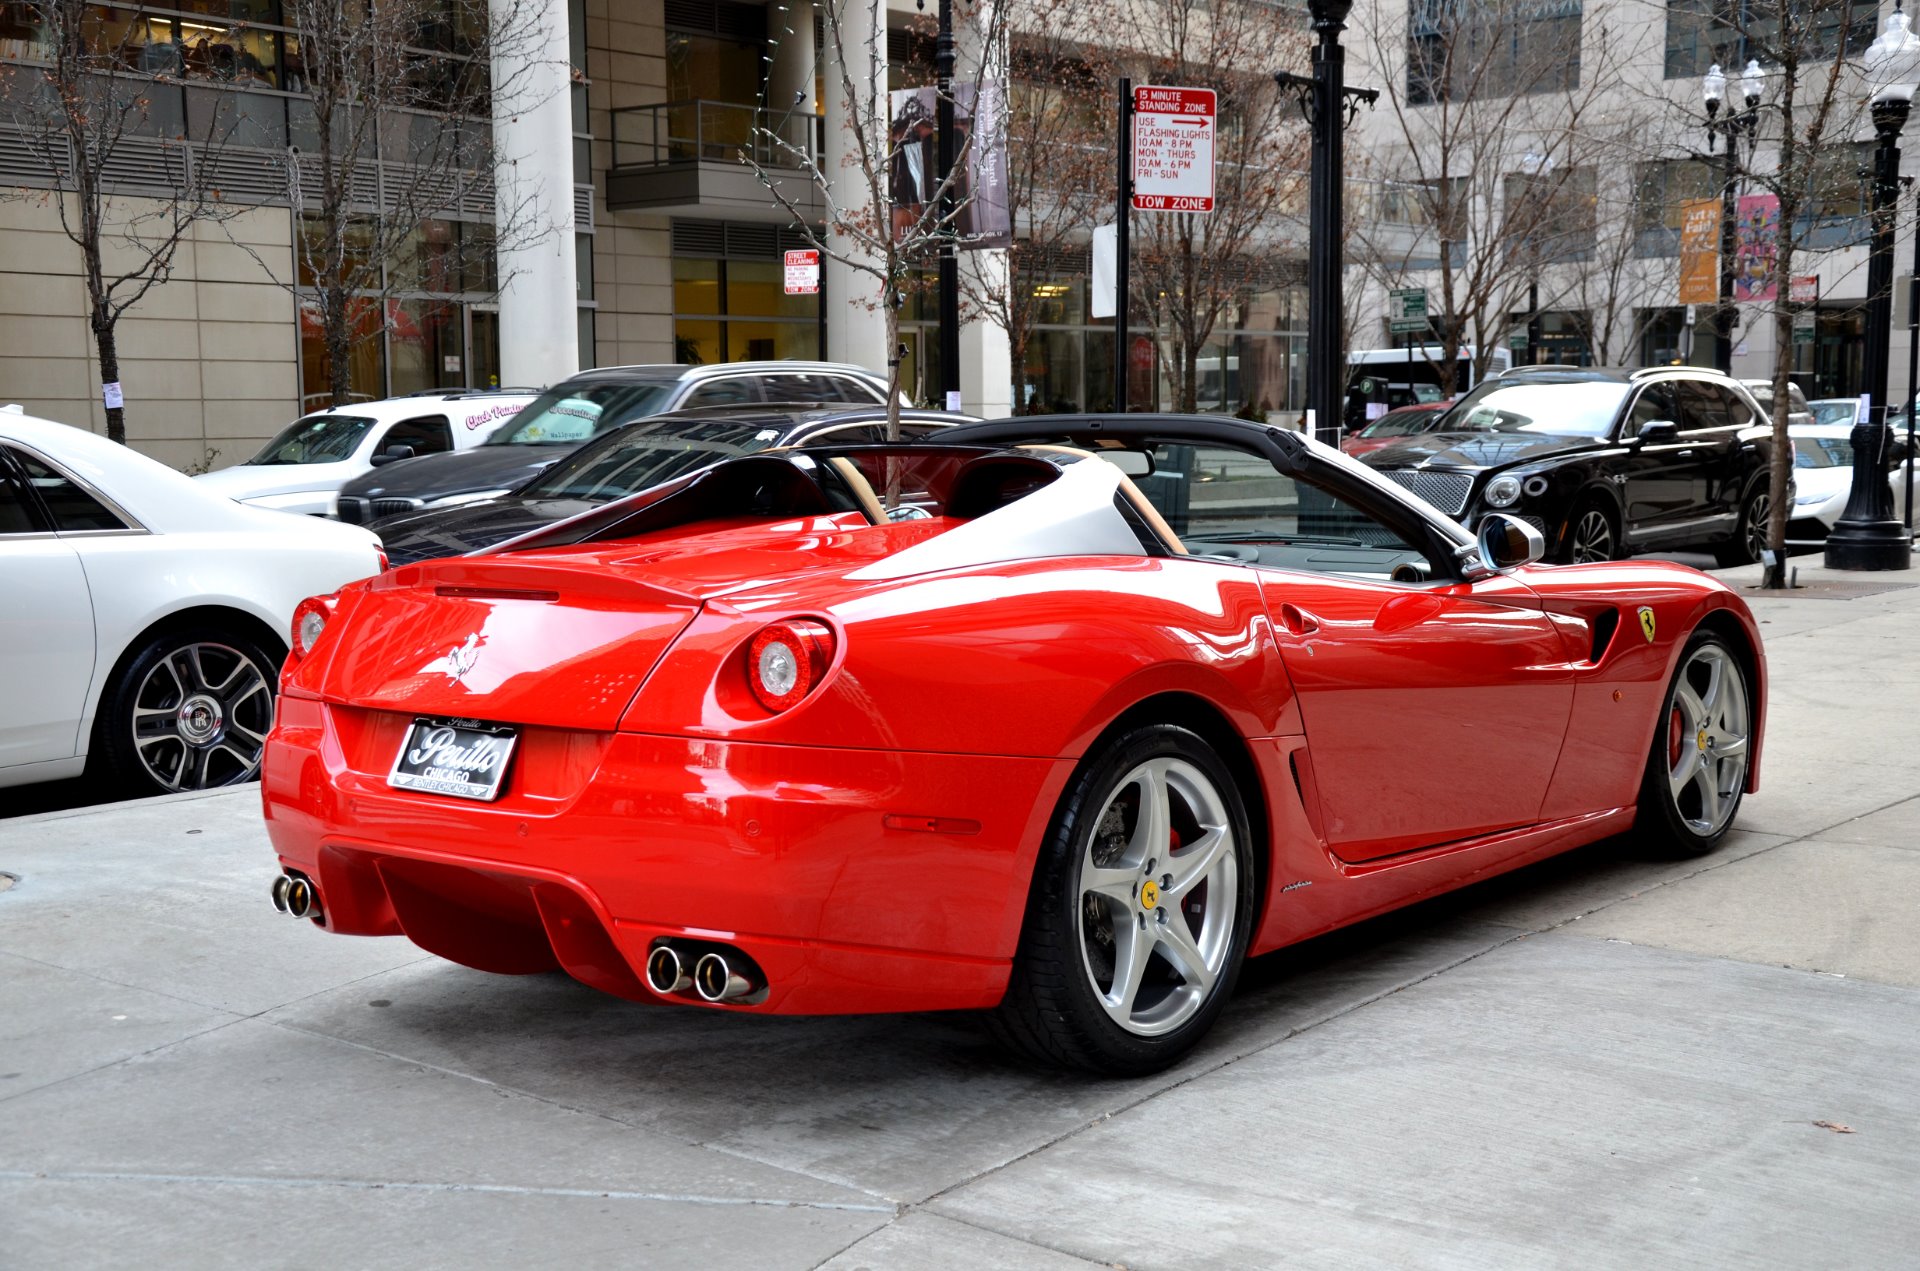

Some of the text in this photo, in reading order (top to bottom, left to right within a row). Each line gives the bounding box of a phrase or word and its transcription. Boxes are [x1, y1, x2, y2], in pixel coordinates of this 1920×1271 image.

[1139, 90, 1182, 101] 15 MINUTE
[1139, 101, 1207, 113] STANDING ZONE
[1139, 117, 1156, 126] USE
[1138, 128, 1210, 140] FLASHING LIGHTS
[1139, 139, 1148, 147] 10
[1148, 139, 1163, 147] AM
[1179, 140, 1192, 149] PM
[1138, 149, 1157, 157] MON
[1167, 150, 1196, 159] THURS
[1138, 159, 1147, 167] 10
[1148, 159, 1161, 168] AM
[1170, 160, 1176, 168] 6
[1178, 160, 1191, 169] PM
[1138, 169, 1152, 177] FRI
[1160, 170, 1179, 179] SUN
[1138, 196, 1207, 210] TOW ZONE
[466, 410, 493, 430] Chick
[408, 727, 500, 773] Perillo
[423, 766, 470, 783] CHICAGO
[412, 778, 469, 794] BENTLEY CHICAGO
